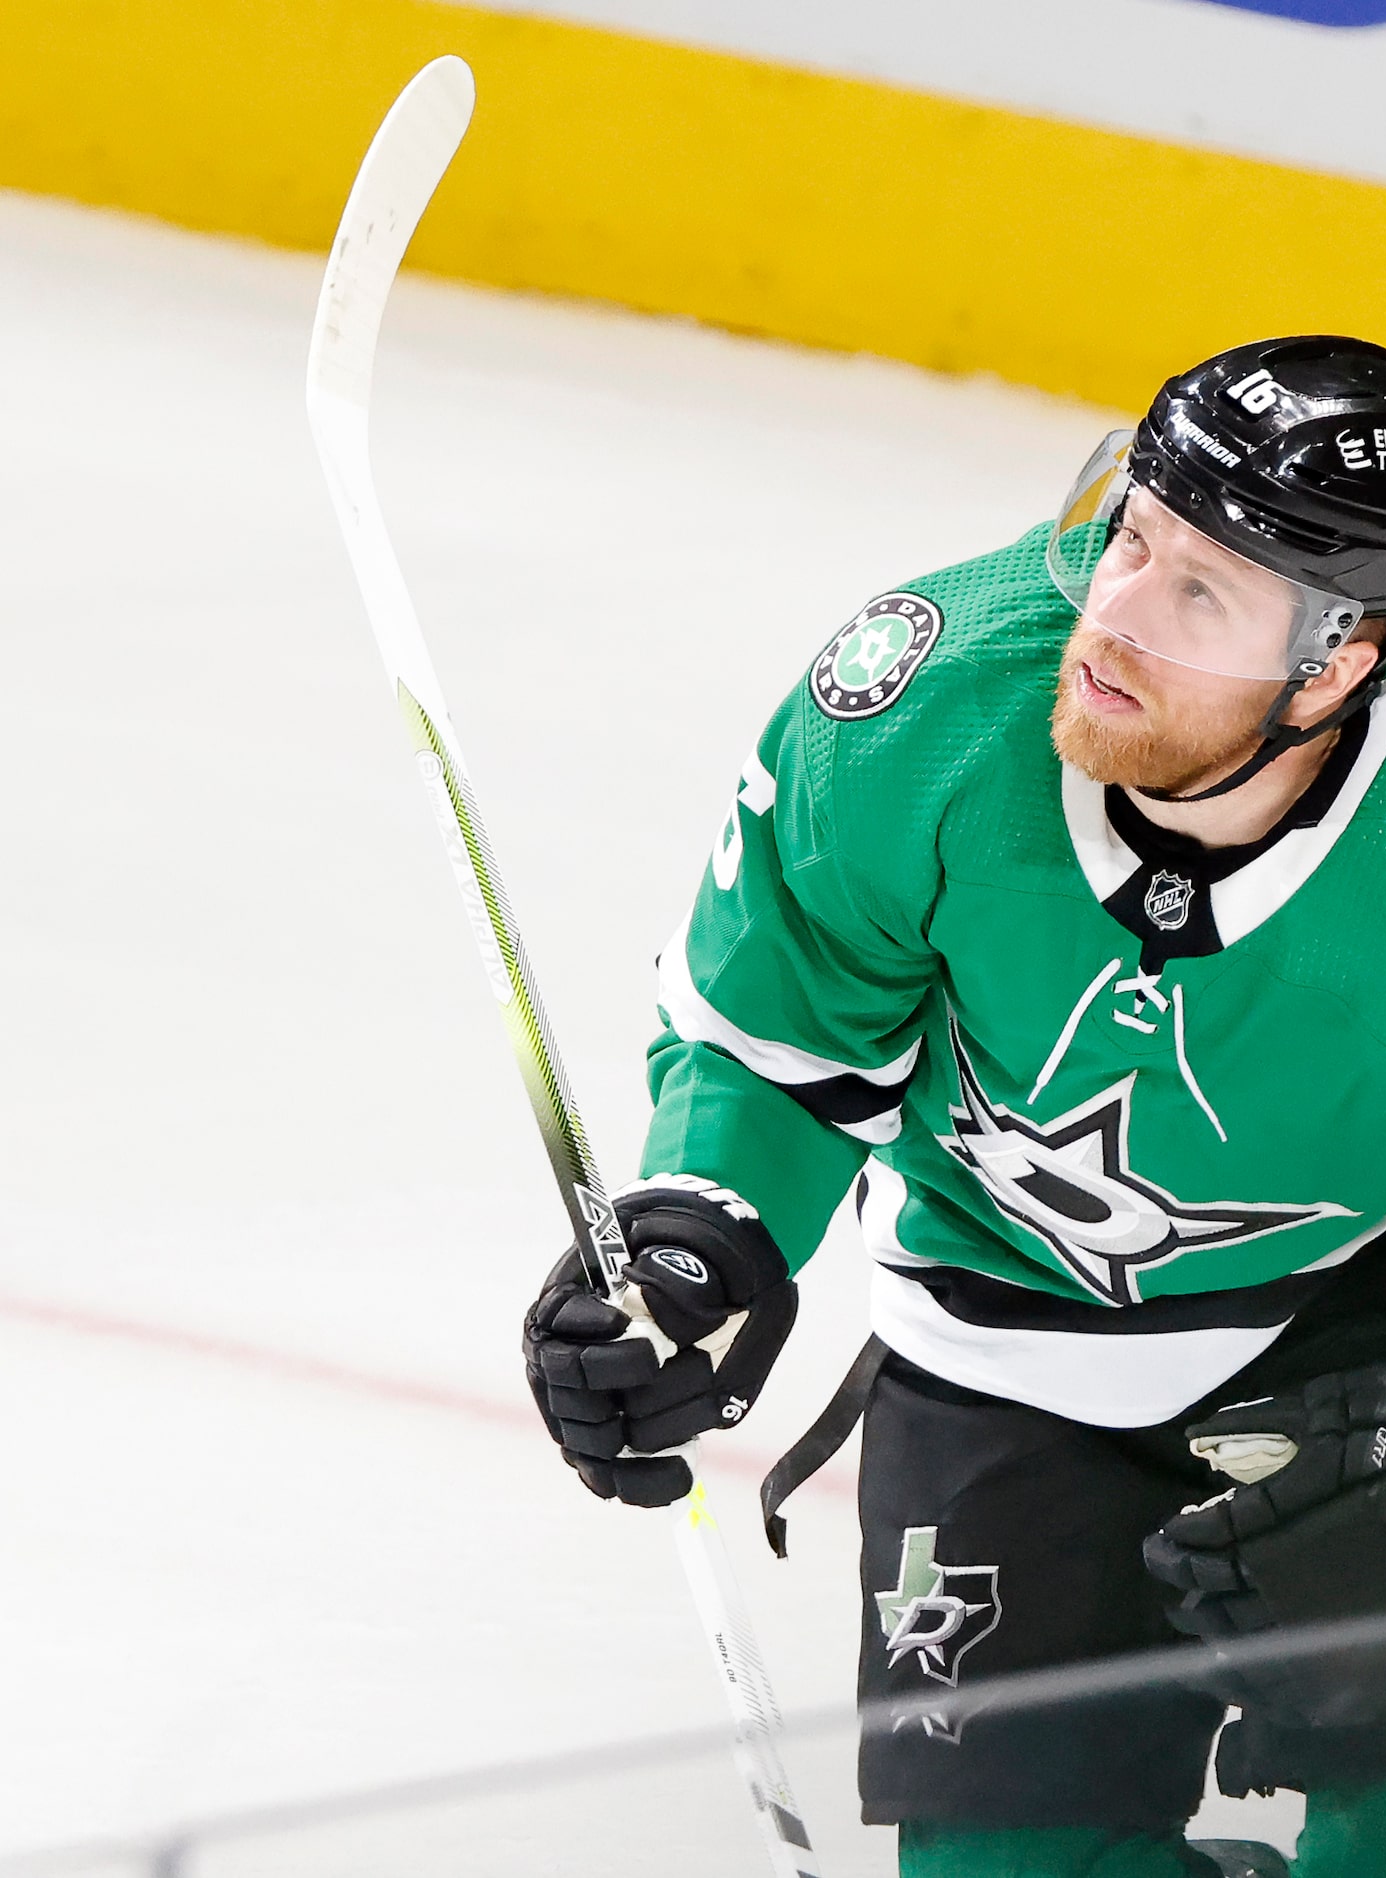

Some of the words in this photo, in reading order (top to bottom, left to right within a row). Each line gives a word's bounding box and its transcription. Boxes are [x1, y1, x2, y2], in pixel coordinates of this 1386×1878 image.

[1226, 368, 1278, 414] 16
[1153, 890, 1183, 913] NHL
[721, 1395, 749, 1421] 16
